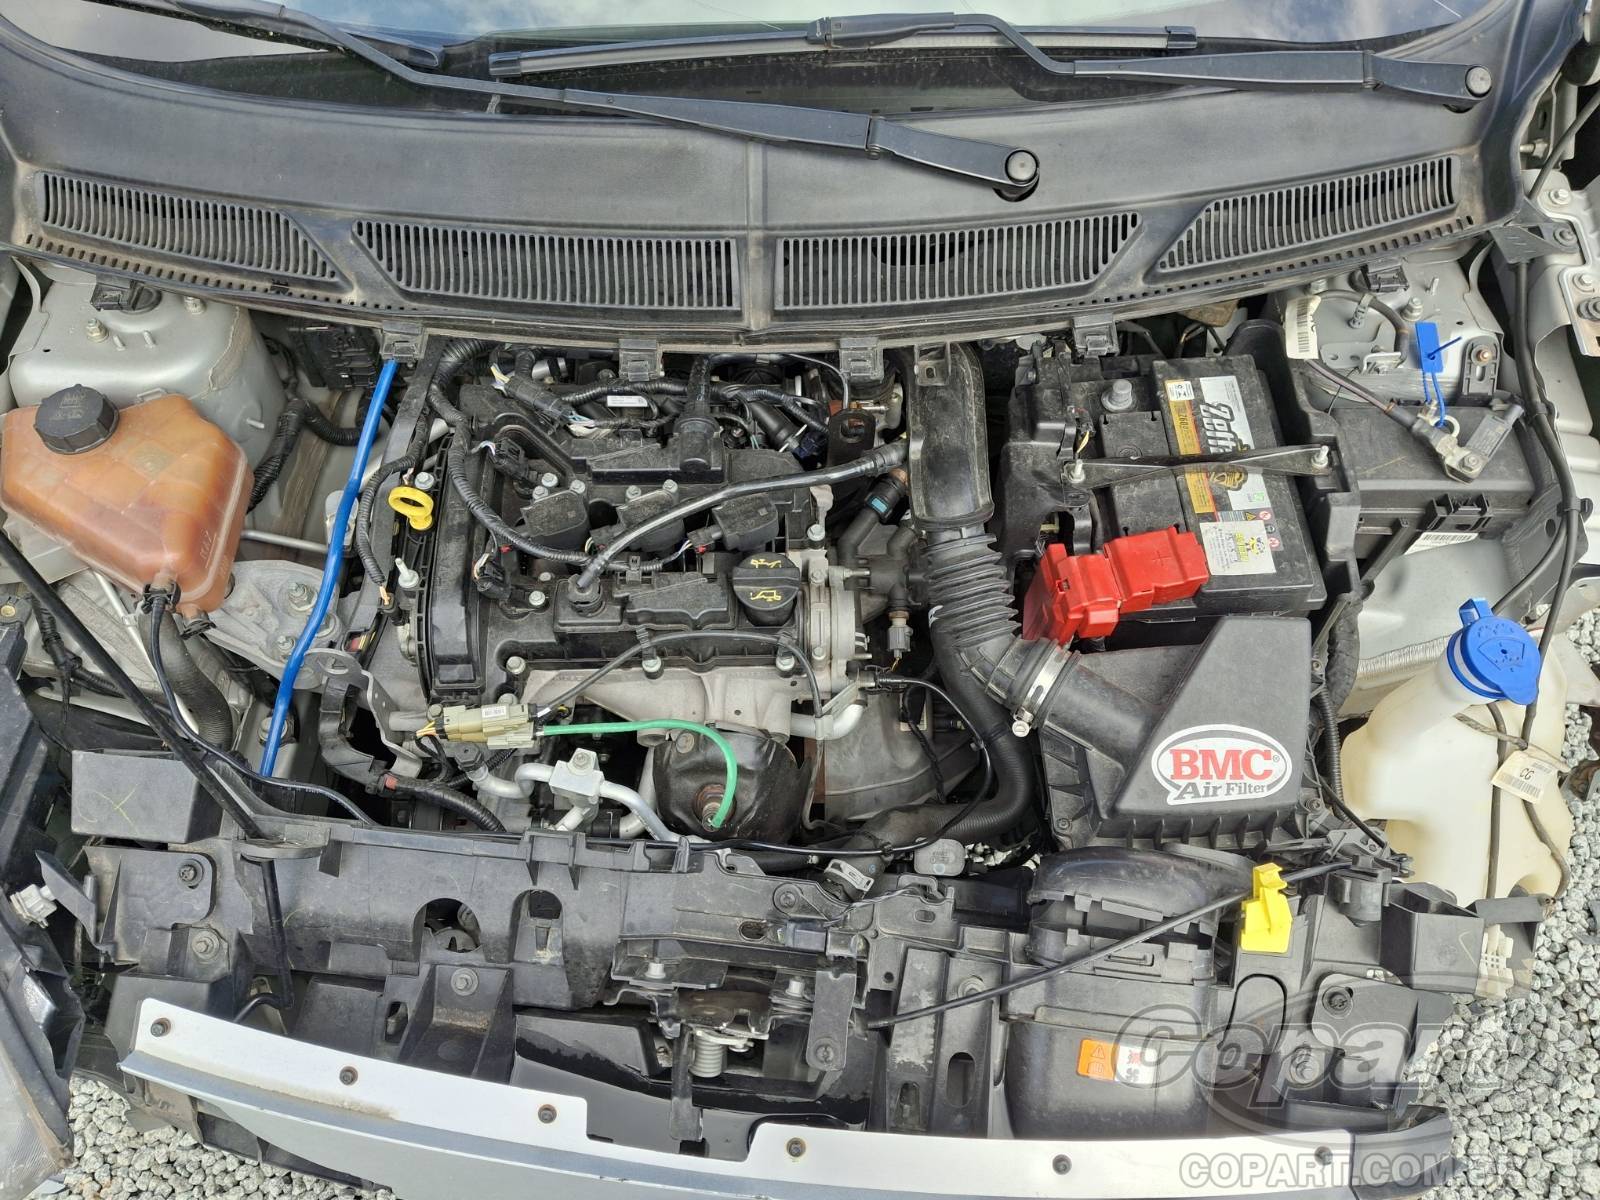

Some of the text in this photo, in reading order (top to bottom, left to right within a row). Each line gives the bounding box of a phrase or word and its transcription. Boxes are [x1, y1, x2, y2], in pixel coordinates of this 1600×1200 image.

[1169, 748, 1273, 781] BMC
[1173, 782, 1266, 801] Air Filter
